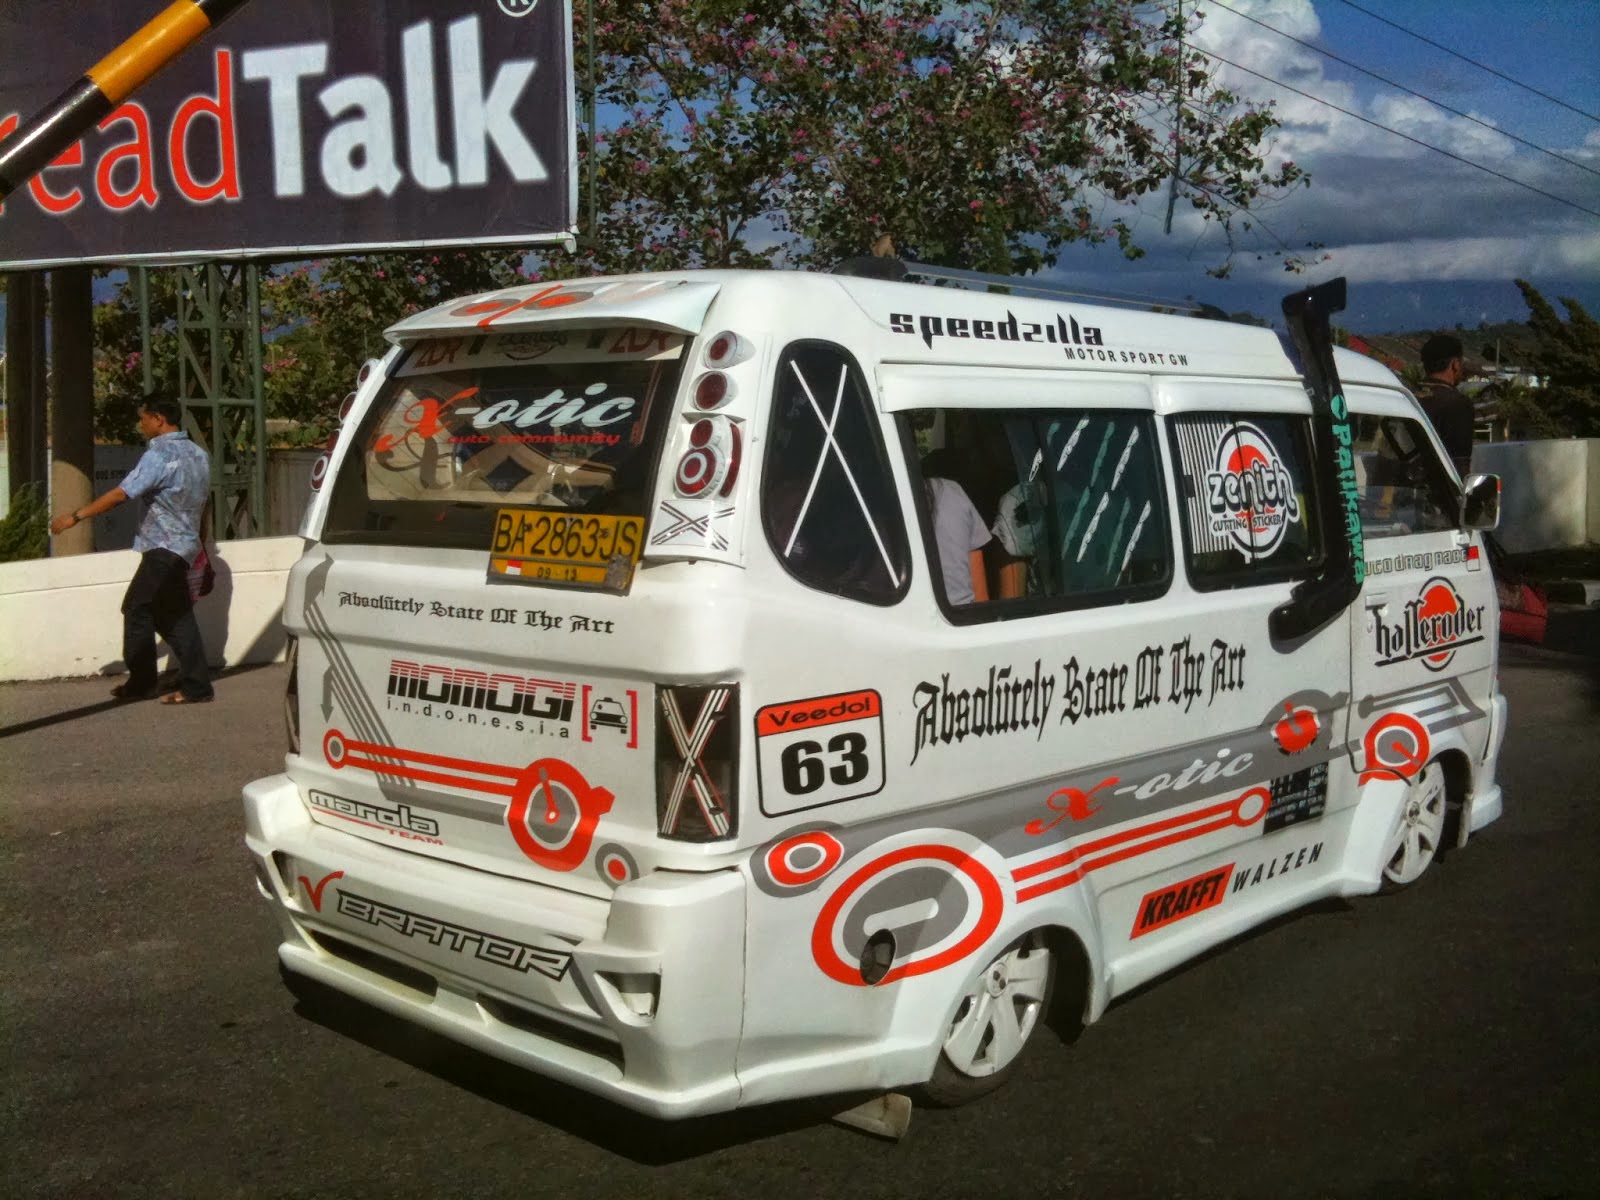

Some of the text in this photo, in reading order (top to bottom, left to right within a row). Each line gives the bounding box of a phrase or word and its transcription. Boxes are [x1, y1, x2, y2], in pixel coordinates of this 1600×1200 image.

[890, 309, 1104, 350] speedzilla
[494, 513, 639, 562] BA 2863 JS
[1212, 514, 1282, 532] CUTTING STICKER
[429, 600, 484, 621] State
[490, 608, 518, 625] Of
[523, 609, 564, 631] The
[569, 614, 615, 635] Art
[1060, 655, 1127, 728] State
[1133, 646, 1163, 710] Of
[1168, 633, 1205, 714] The
[1209, 637, 1246, 712] Art
[768, 696, 870, 727] Veedol
[780, 731, 870, 796] 63
[384, 829, 444, 846] TEAM
[1139, 841, 1324, 930] KRAFFT WALZEN
